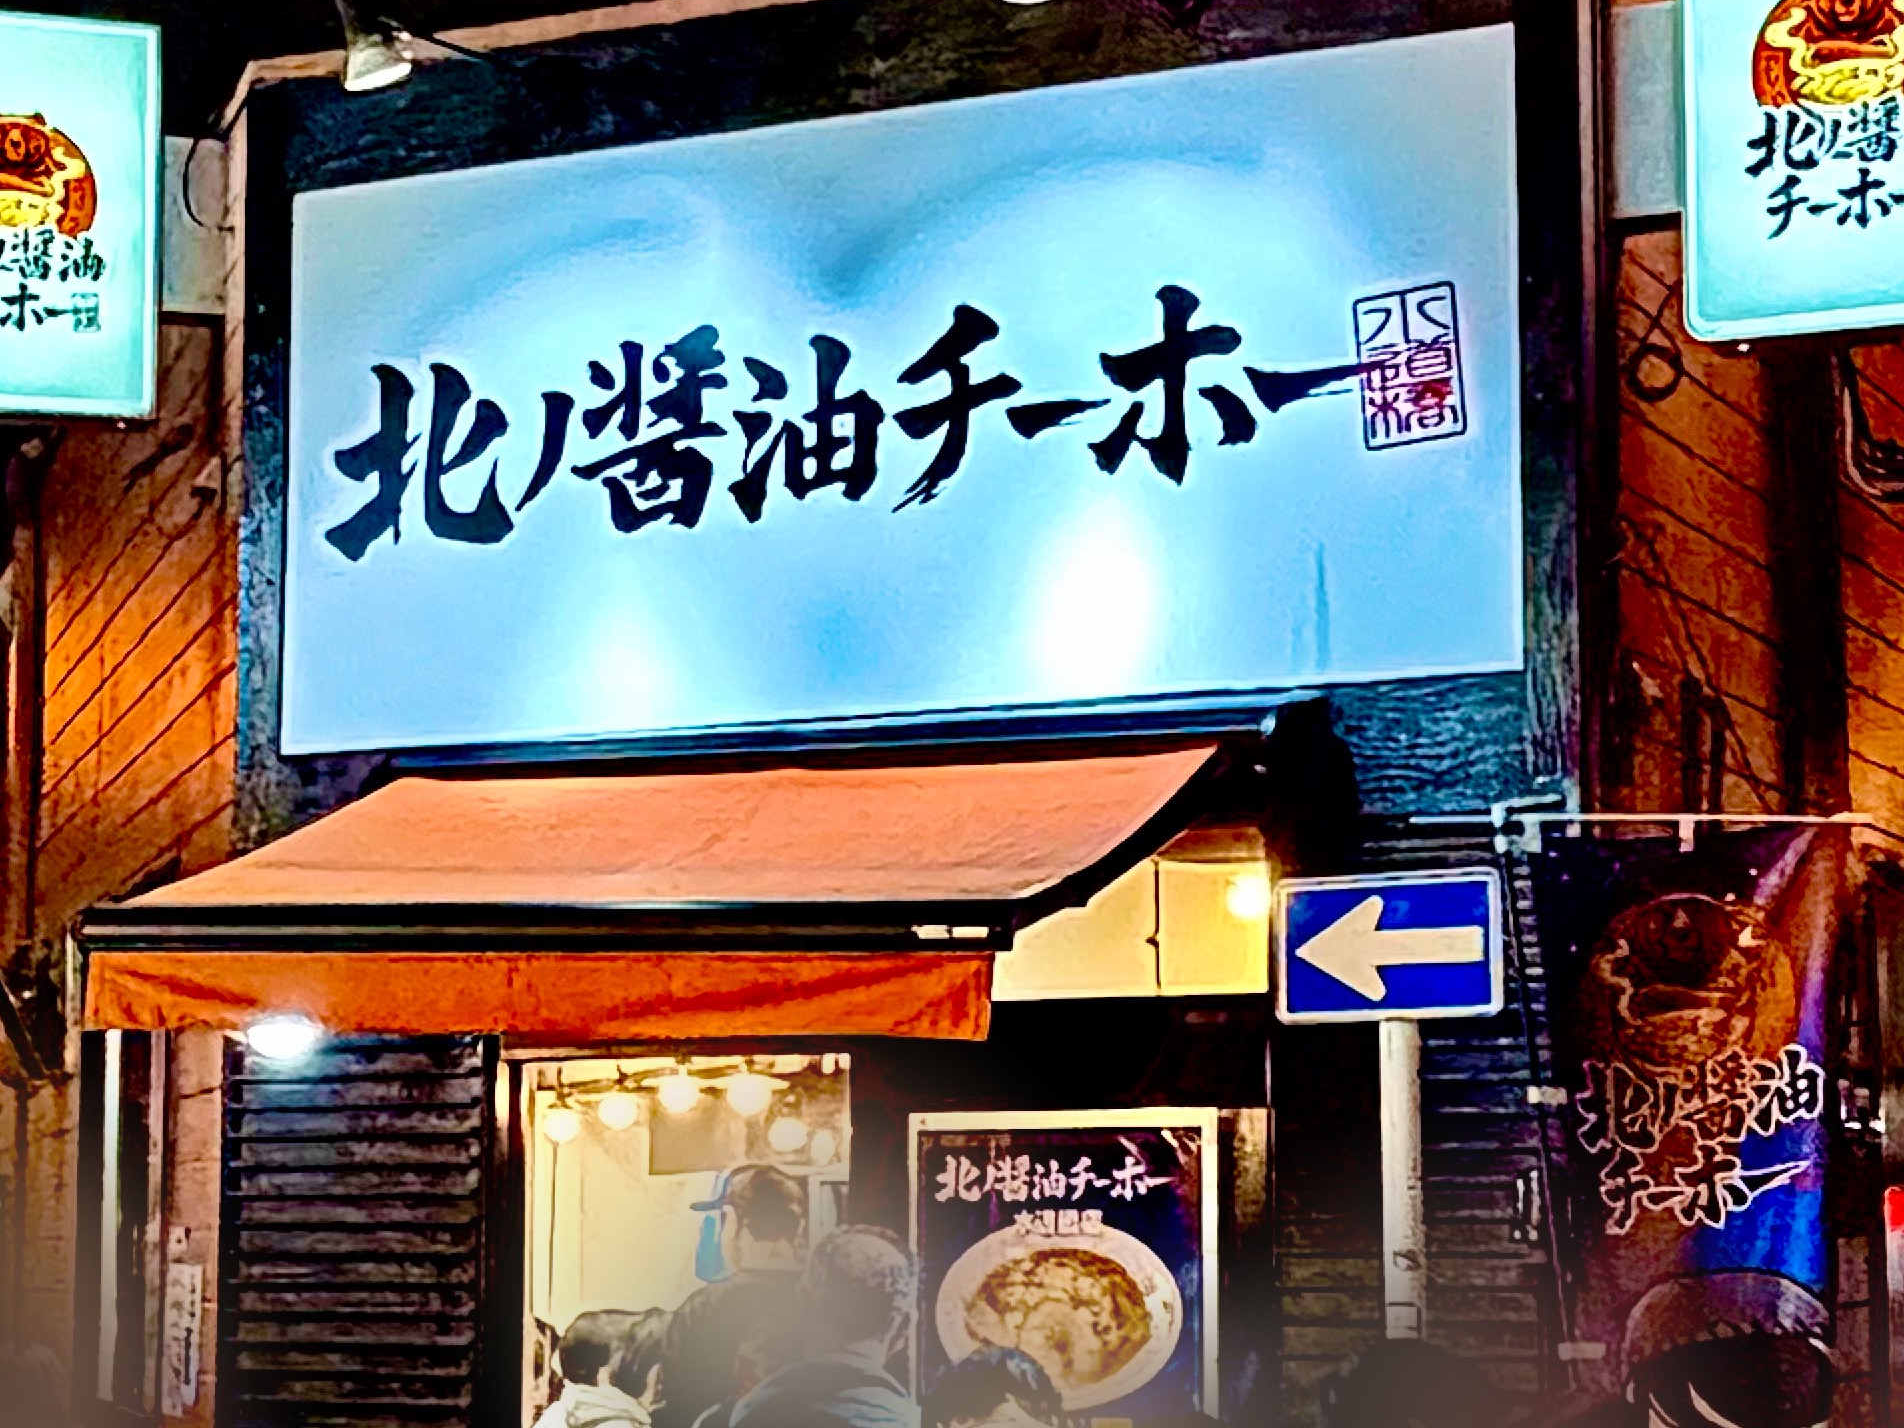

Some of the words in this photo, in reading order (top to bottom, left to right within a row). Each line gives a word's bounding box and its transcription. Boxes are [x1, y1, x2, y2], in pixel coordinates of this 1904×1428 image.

[324, 284, 1384, 562] 北ノ醤油チーホー
